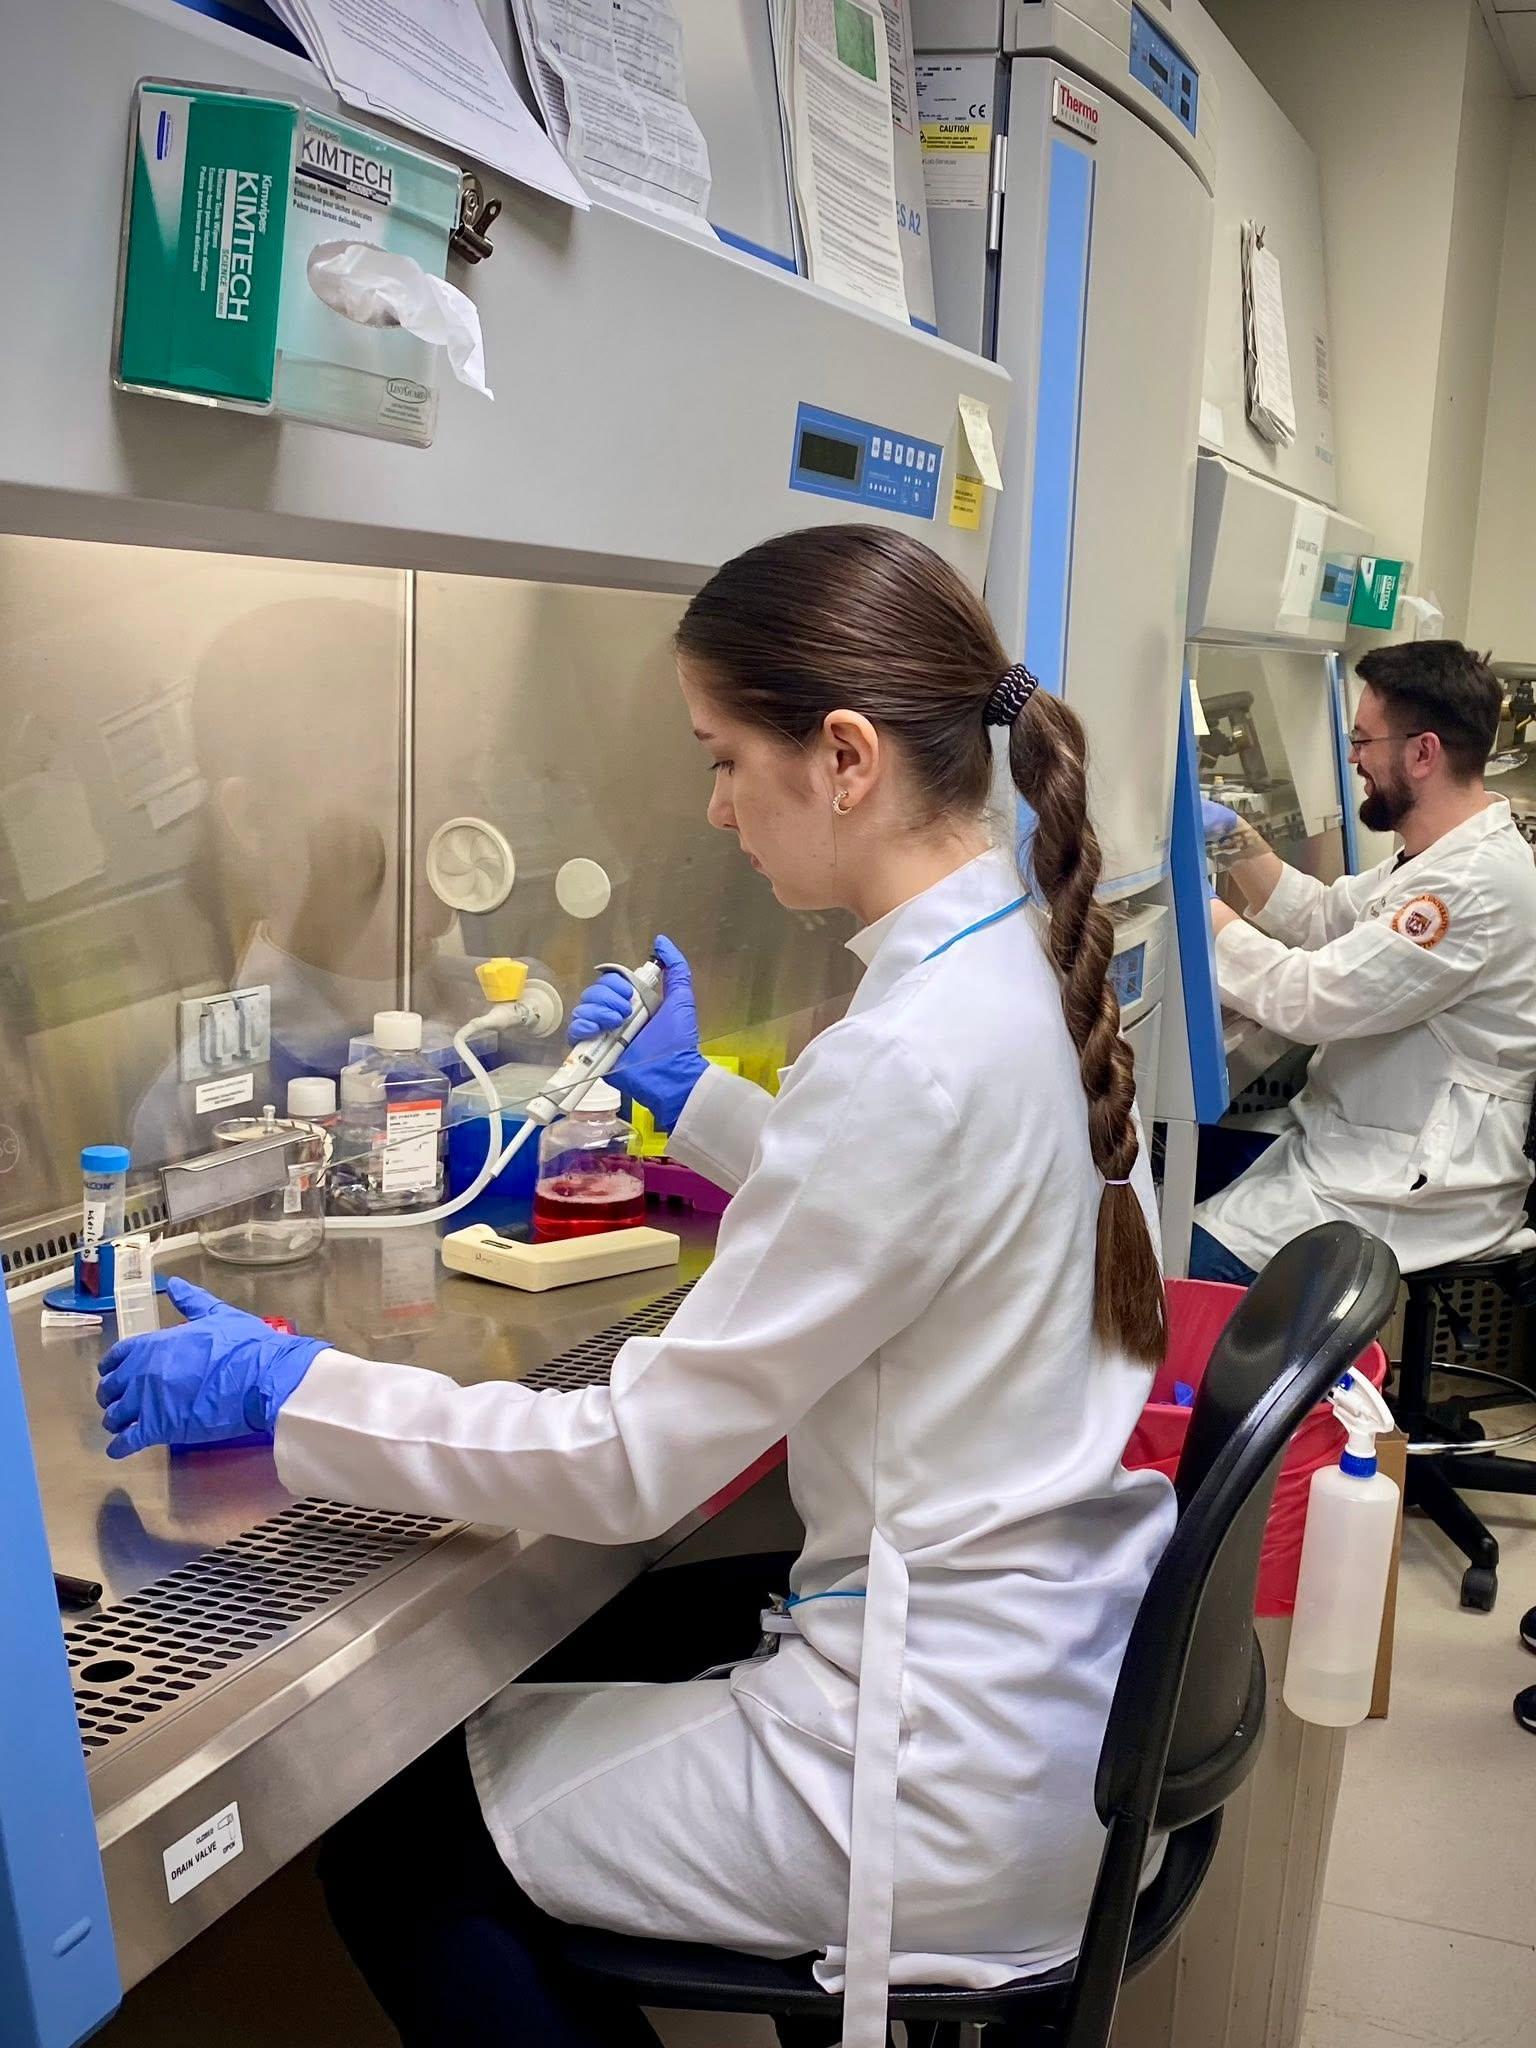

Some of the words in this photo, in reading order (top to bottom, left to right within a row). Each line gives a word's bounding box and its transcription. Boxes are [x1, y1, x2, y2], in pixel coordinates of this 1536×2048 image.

[969, 104, 986, 118] CE
[1060, 84, 1098, 124] Thermo
[939, 125, 970, 133] CAUTION
[302, 137, 392, 192] KIMTECH
[258, 174, 273, 235] Kimwipes
[908, 209, 921, 236] A2
[228, 171, 259, 322] KIMTECH
[220, 248, 230, 287] SCIENCE
[1381, 575, 1393, 610] KIMTECH
[83, 1181, 114, 1190] LCON
[171, 1858, 194, 1880] DRAIN
[194, 1841, 217, 1863] VALVE
[222, 1841, 236, 1854] OPEN
